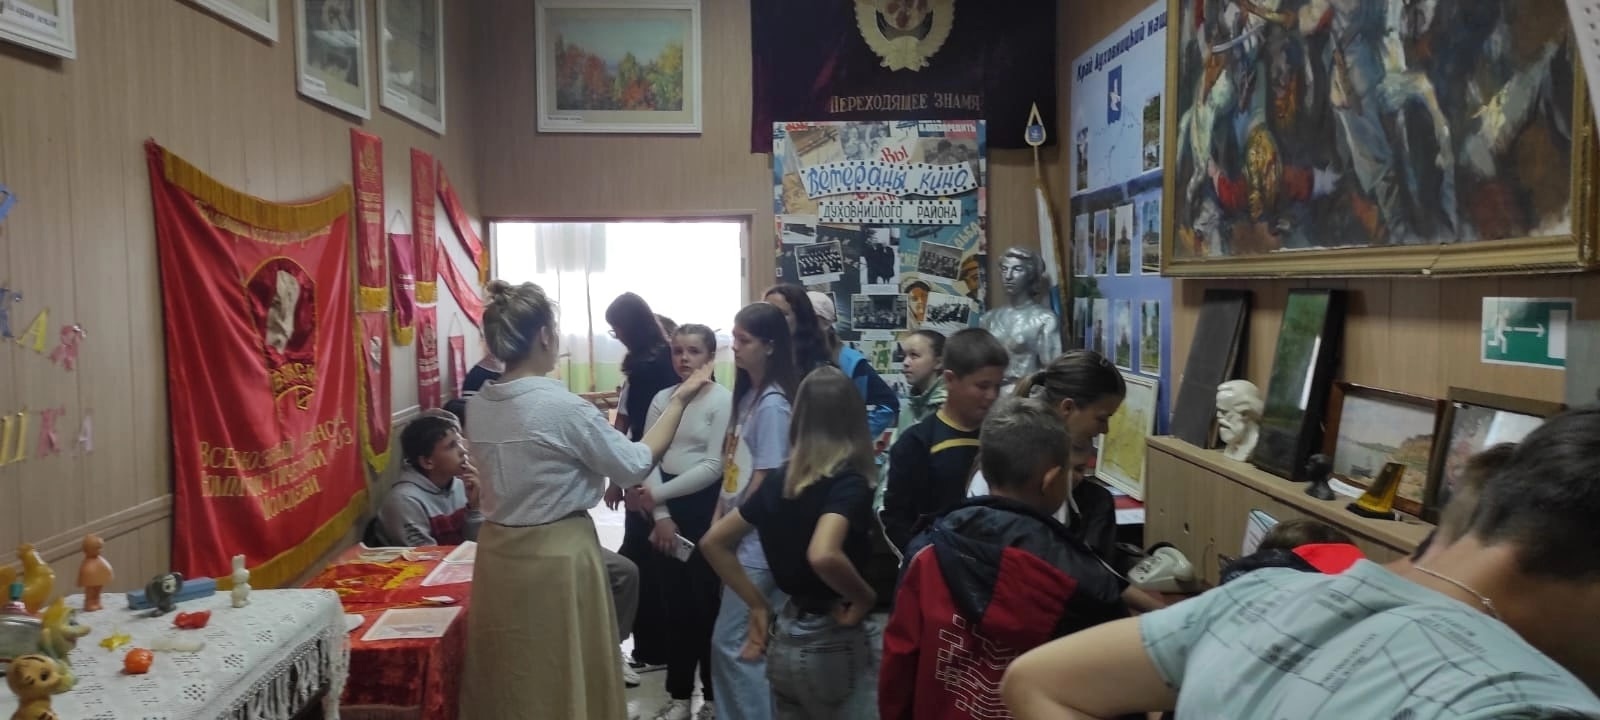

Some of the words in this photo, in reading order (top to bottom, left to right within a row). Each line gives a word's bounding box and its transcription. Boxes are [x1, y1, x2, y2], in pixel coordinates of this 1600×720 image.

[1077, 55, 1093, 83] Край
[830, 93, 929, 113] ПЕРЕХОДЯЩЕЕ
[934, 92, 980, 111] ЗНАМЯ
[806, 165, 908, 195] Ветераны
[919, 168, 969, 191] кино
[823, 204, 903, 219] ДУХОВНИЦКОГО
[916, 204, 958, 219] РАЙОНА
